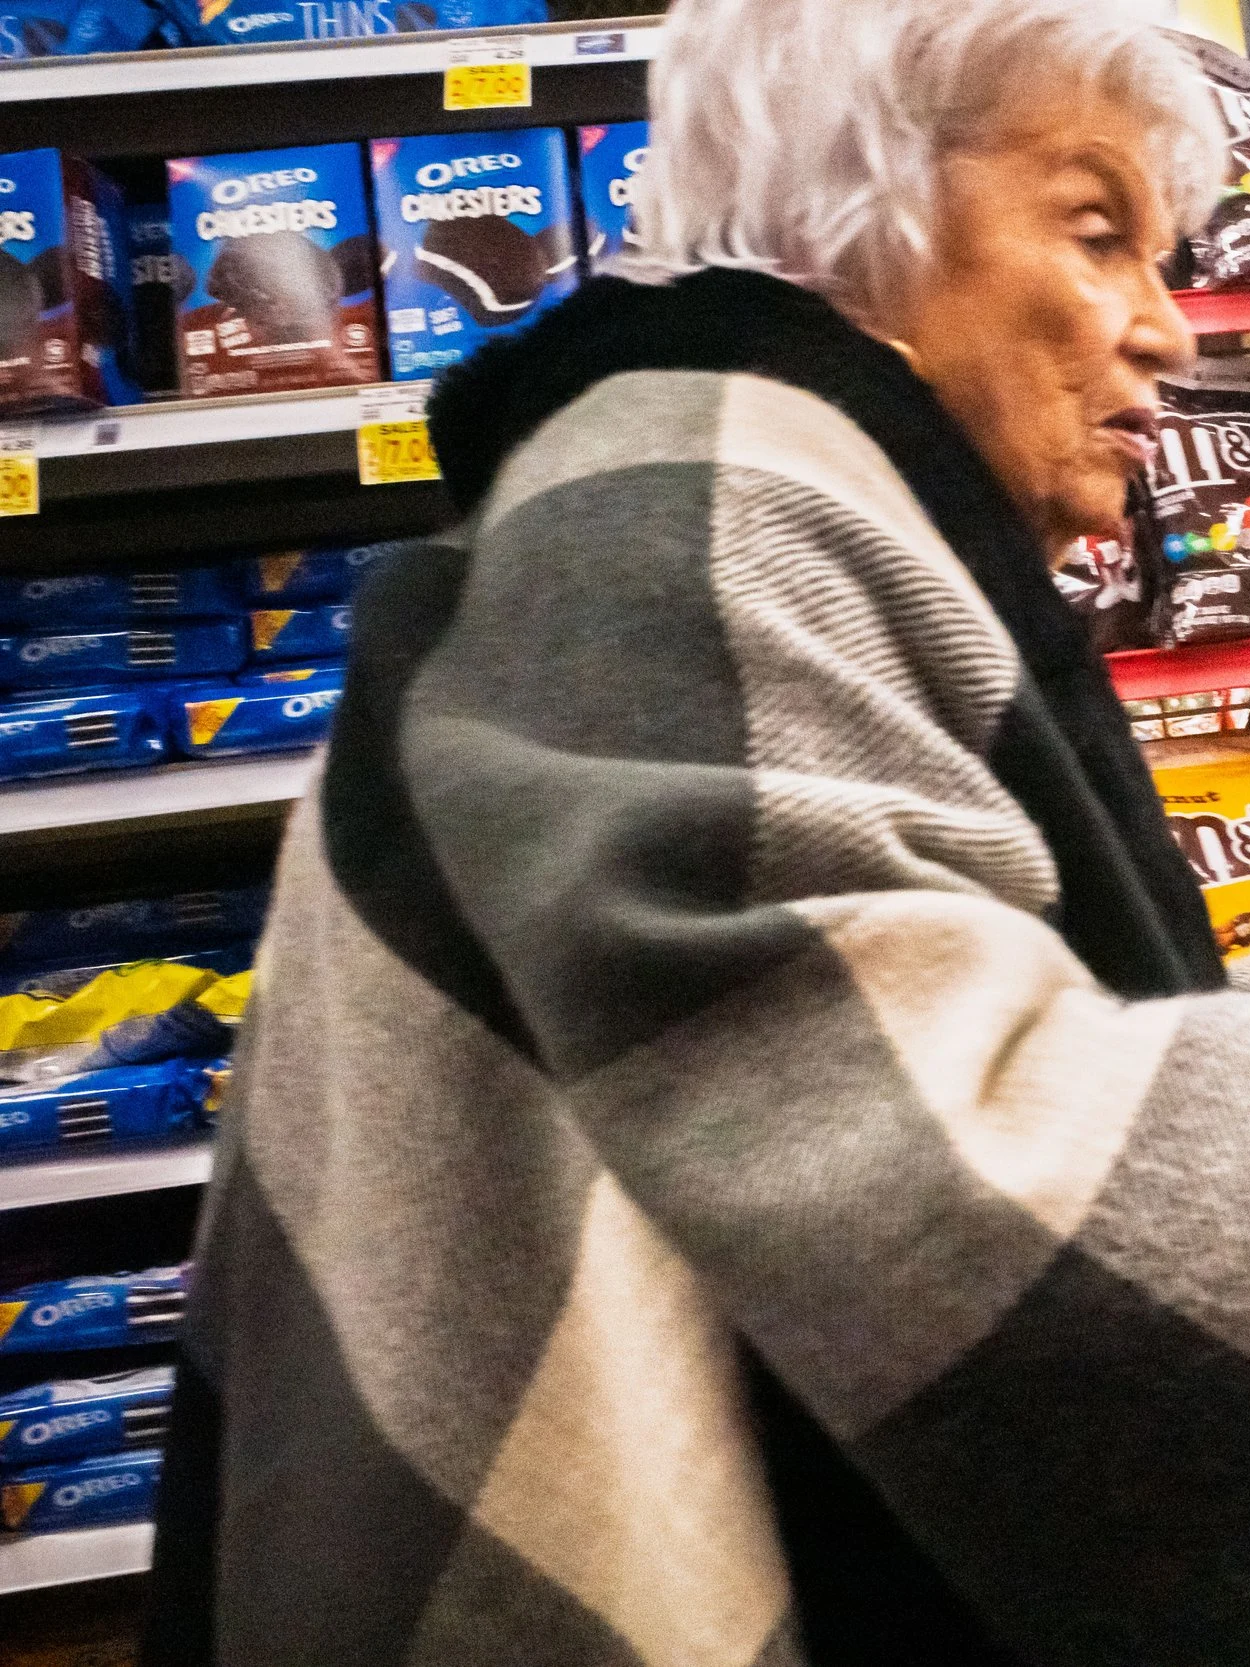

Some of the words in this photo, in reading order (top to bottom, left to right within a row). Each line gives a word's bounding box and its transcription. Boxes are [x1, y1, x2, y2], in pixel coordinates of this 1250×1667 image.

[212, 167, 318, 205] OREO
[416, 153, 522, 187] OREO
[196, 199, 338, 241] CAKESTERS
[402, 184, 542, 223] CAKESTERS
[21, 1409, 113, 1445] OREO
[53, 1472, 142, 1507] OREO
